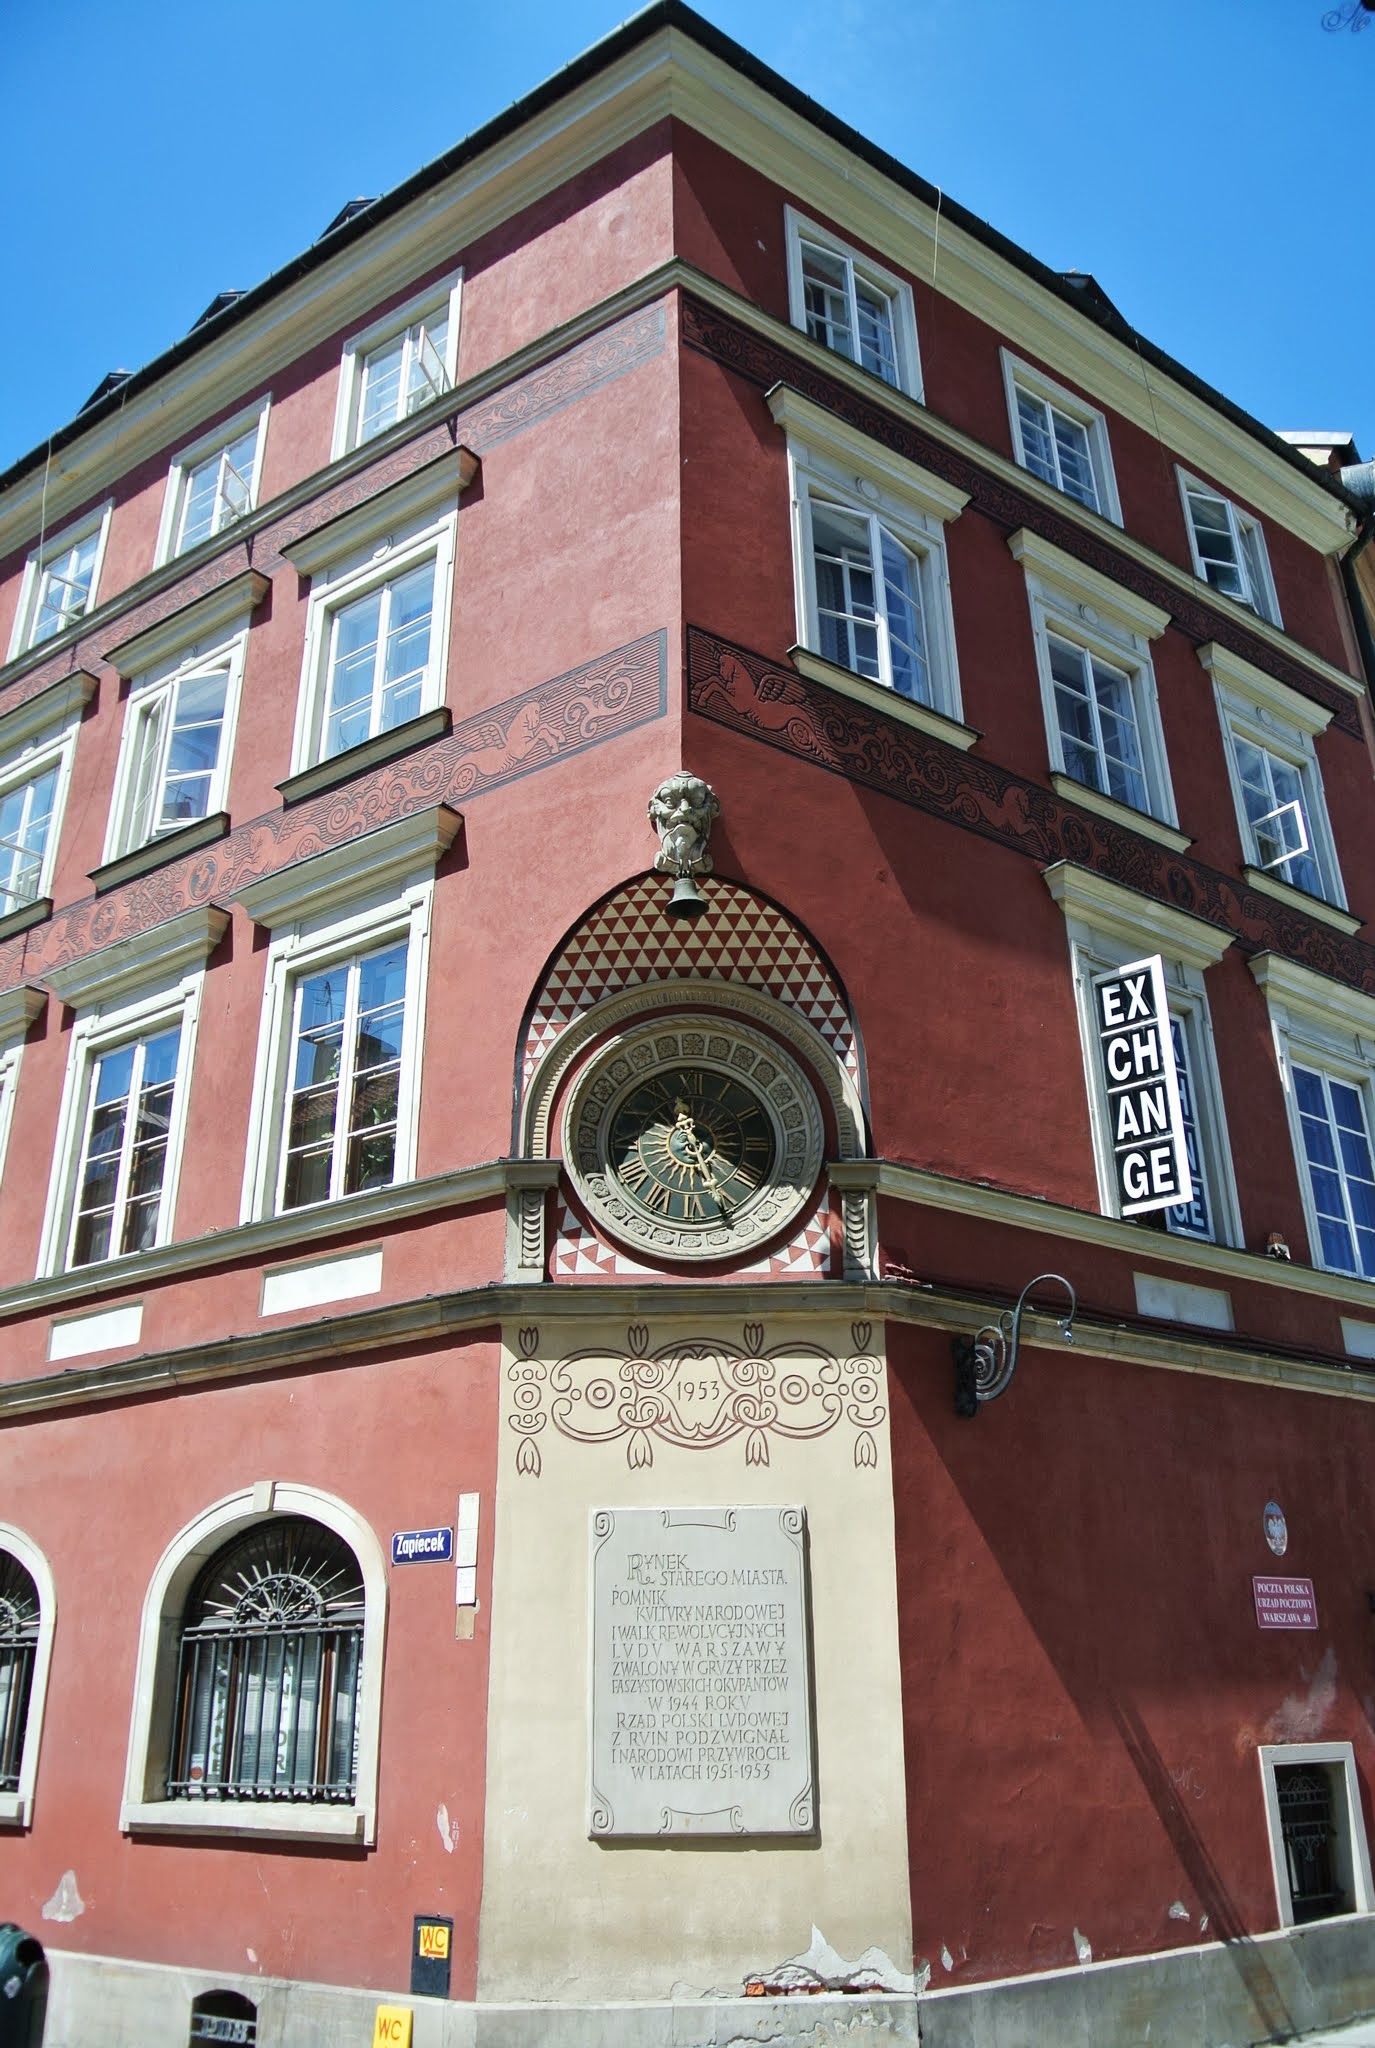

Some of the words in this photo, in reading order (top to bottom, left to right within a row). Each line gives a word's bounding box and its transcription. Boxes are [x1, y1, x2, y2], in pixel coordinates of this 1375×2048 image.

[1101, 974, 1150, 1027] EX
[1107, 1029, 1160, 1081] CH
[1116, 1086, 1168, 1141] AN
[1122, 1147, 1175, 1199] GE
[677, 1381, 720, 1402] 1953
[396, 1531, 445, 1559] Zapiecek
[627, 1553, 690, 1586] RYNEK
[660, 1570, 728, 1586] STAREGO
[732, 1569, 788, 1585] MIASTA.
[612, 1589, 668, 1606] POMNIK
[1257, 1583, 1283, 1594] POCZTA
[1283, 1584, 1310, 1595] POLSKA
[1279, 1598, 1312, 1609] POCZTOWY
[695, 1604, 785, 1621] NARODOWEJ
[1262, 1612, 1301, 1623] WARSZAWA
[1302, 1613, 1311, 1624] 40
[618, 1625, 658, 1641] WALK
[675, 1641, 786, 1658] WARSZAWY
[612, 1660, 680, 1676] ZWALONY
[682, 1660, 695, 1676] W
[746, 1658, 788, 1675] PRZEZ
[611, 1677, 712, 1694] FASZYSTOWSKICH
[648, 1696, 663, 1712] W
[669, 1696, 699, 1712] 1944
[662, 1712, 713, 1728] POLSKI
[611, 1731, 621, 1746] Z
[619, 1748, 693, 1764] NARODOWI
[631, 1765, 646, 1781] W
[649, 1764, 701, 1781] LATACH
[706, 1763, 771, 1782] 1951-1953
[422, 1926, 447, 1949] WC
[378, 2017, 402, 2041] WC
